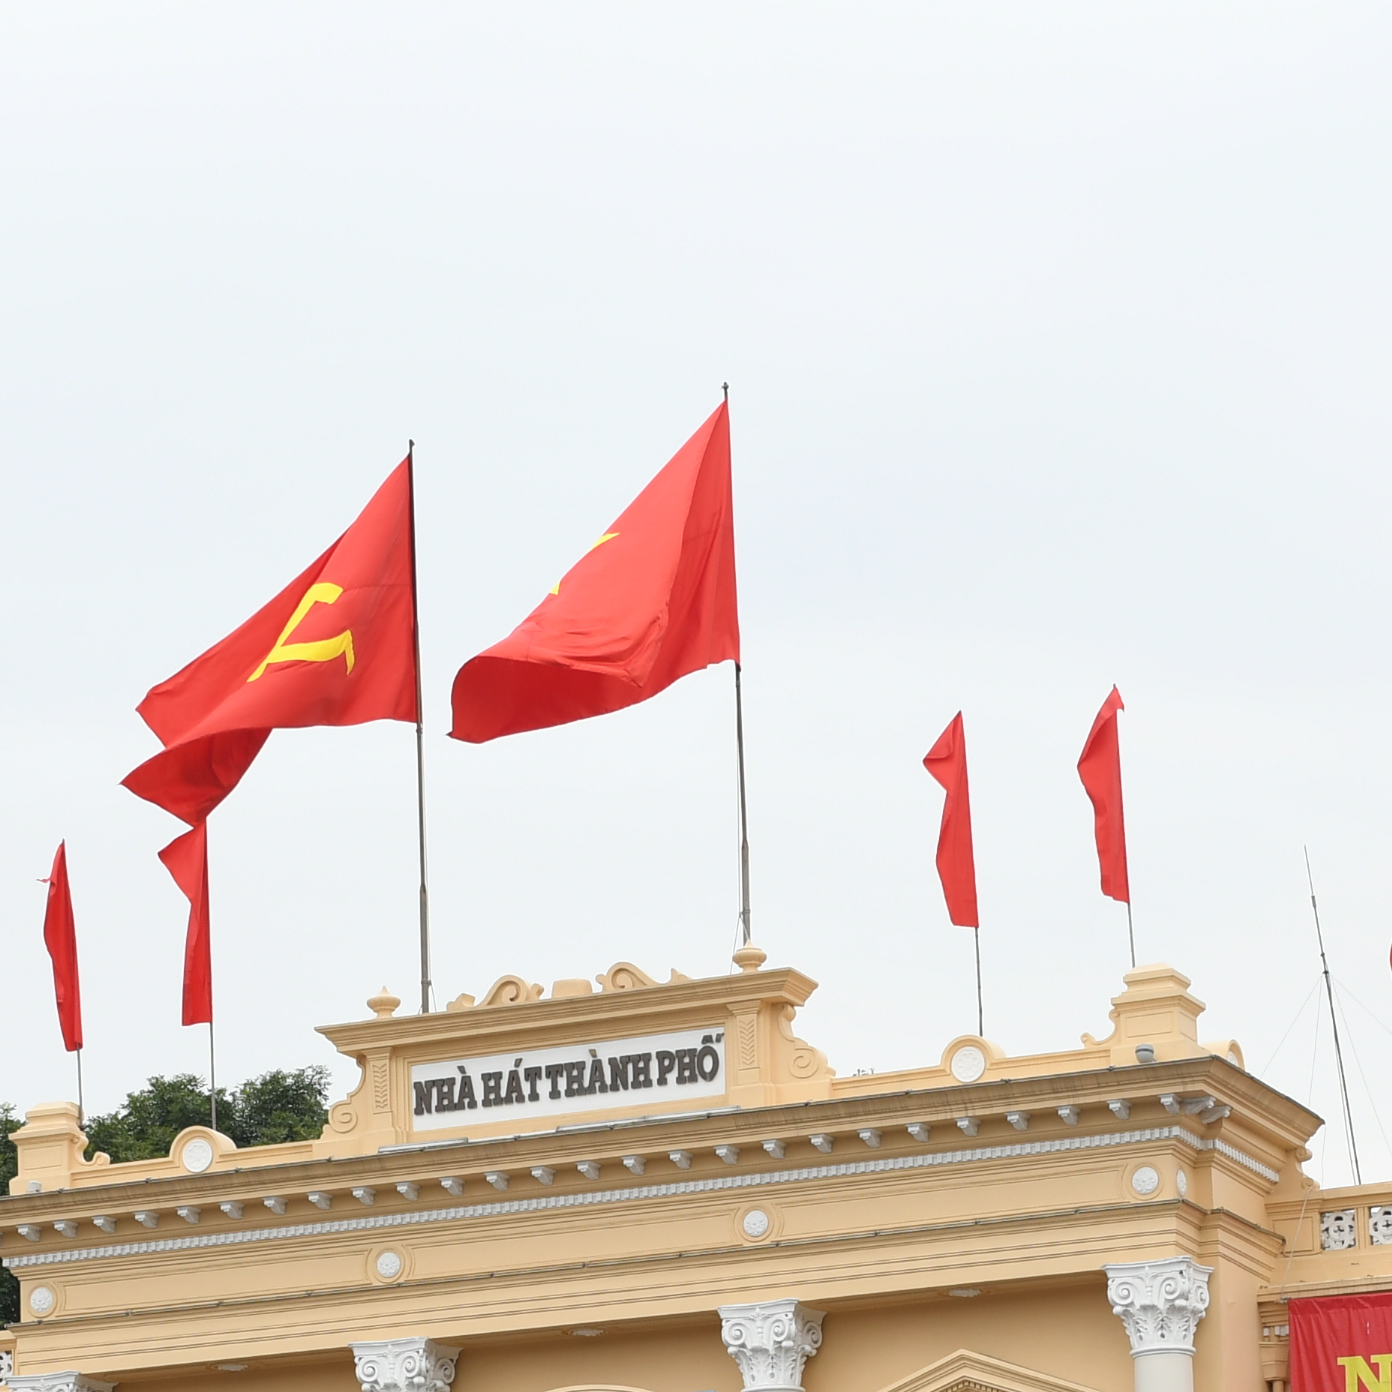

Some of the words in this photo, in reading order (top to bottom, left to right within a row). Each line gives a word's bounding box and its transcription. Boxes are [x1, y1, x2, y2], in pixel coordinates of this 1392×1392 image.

[413, 1065, 477, 1116] NHÀ
[481, 1058, 542, 1107] HÁT
[545, 1048, 652, 1100] THÀNH
[655, 1032, 725, 1085] PHỐ
